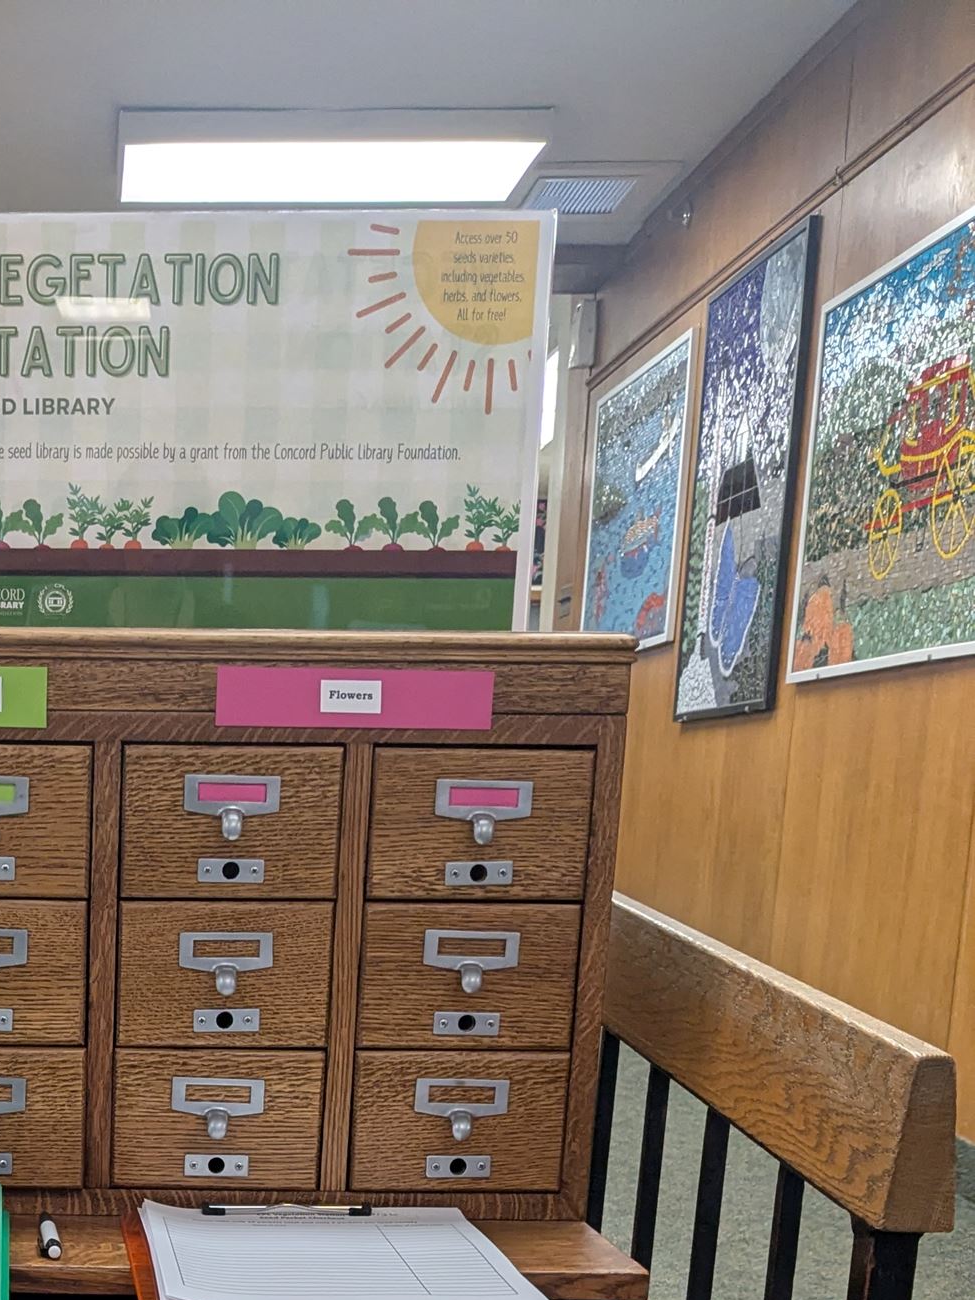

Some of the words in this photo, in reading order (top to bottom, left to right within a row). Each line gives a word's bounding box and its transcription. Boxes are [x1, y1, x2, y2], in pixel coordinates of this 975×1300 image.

[455, 231, 482, 245] Access
[485, 234, 502, 243] over
[506, 232, 518, 244] 50
[453, 251, 476, 264] seeds
[441, 270, 477, 285] including
[472, 289, 486, 302] and
[457, 308, 469, 321] All
[472, 308, 484, 320] for
[488, 308, 506, 320] free!
[24, 397, 115, 416] LIBRARY
[8, 443, 32, 459] seed
[36, 442, 70, 462] library
[73, 444, 82, 460] is
[86, 443, 113, 459] made
[117, 443, 159, 462] possible
[163, 443, 175, 462] by
[179, 446, 186, 459] a
[190, 445, 218, 463] grant
[224, 444, 247, 460] from
[252, 443, 270, 460] the
[274, 444, 316, 460] Concord
[320, 443, 353, 460] Public
[358, 444, 392, 463] Library
[397, 443, 461, 460] Foundation.
[329, 690, 373, 700] Flowers
